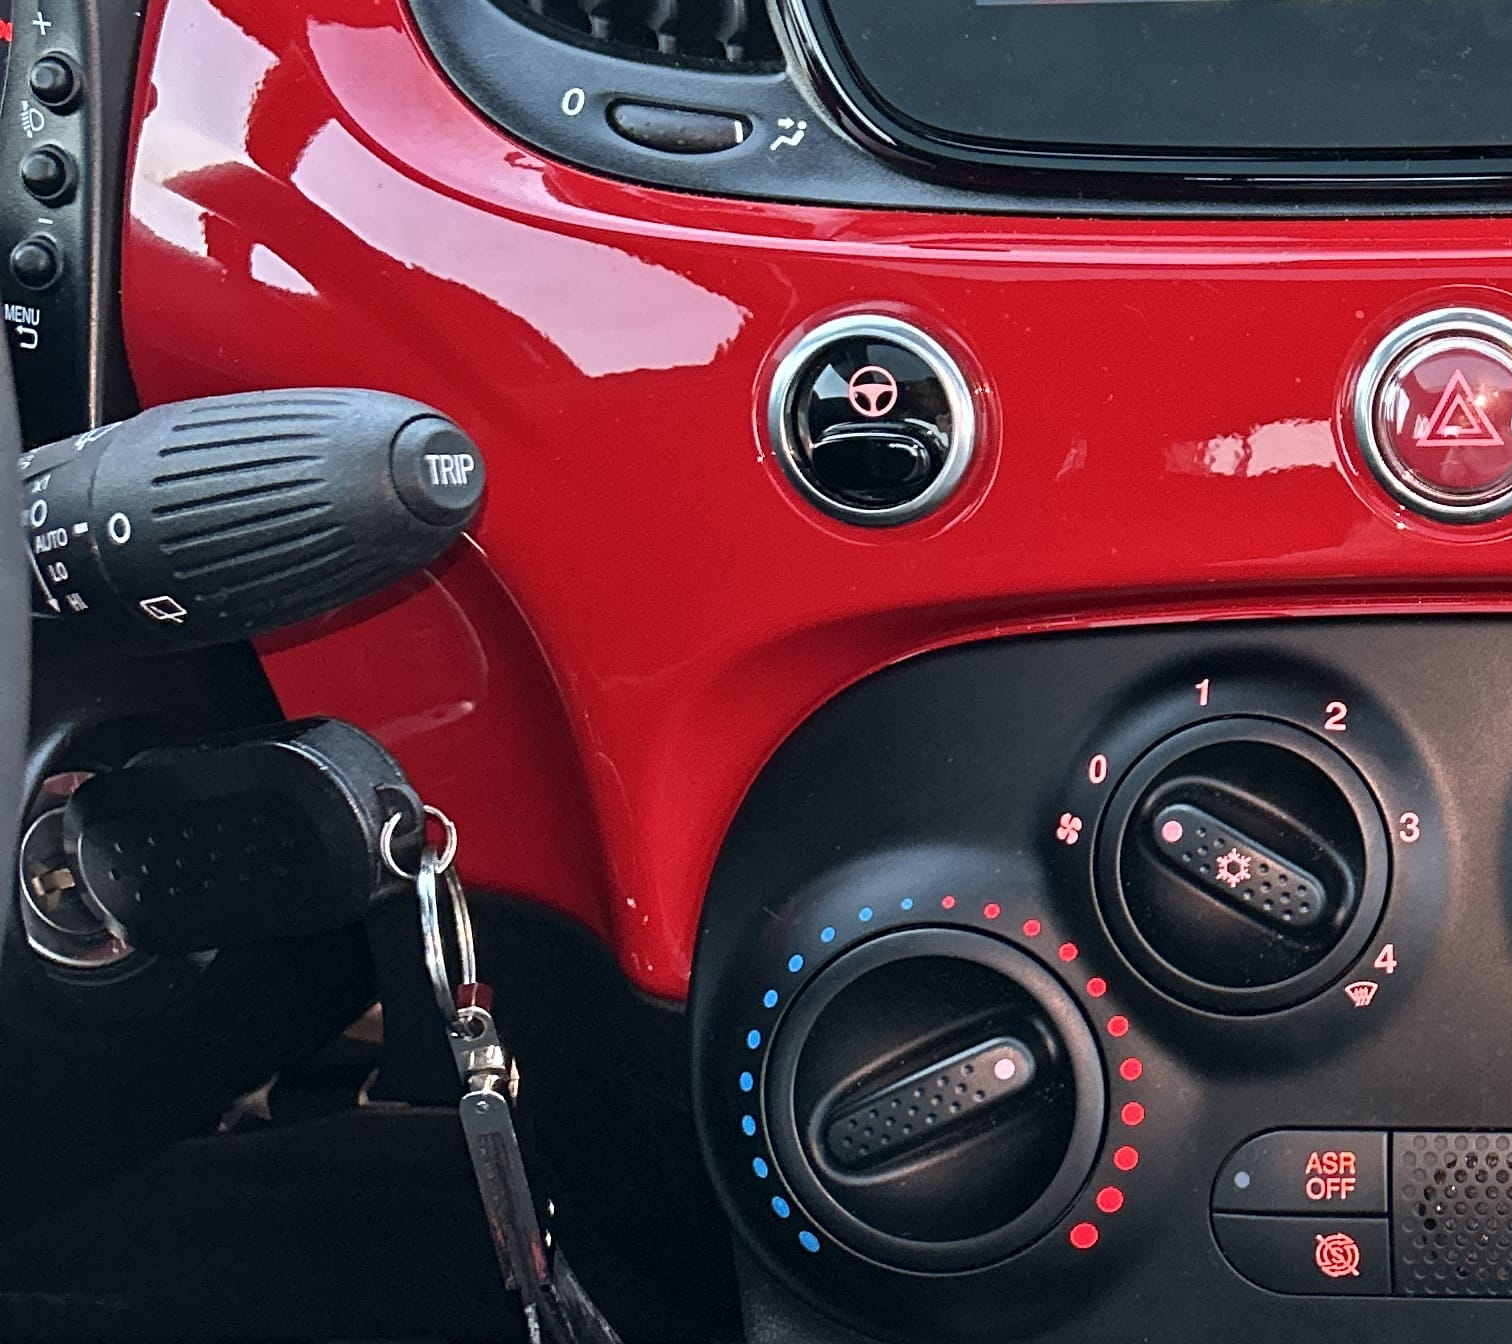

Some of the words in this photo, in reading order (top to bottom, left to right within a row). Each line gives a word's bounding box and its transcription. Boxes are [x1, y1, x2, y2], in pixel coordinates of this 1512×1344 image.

[4, 303, 40, 326] MENU
[423, 454, 475, 486] TRIP
[35, 527, 68, 554] AUTO
[48, 561, 69, 583] LO
[1195, 678, 1210, 706] 1
[1324, 701, 1347, 731] 2
[1398, 812, 1421, 843] 3
[1373, 943, 1398, 974] 4
[1304, 1151, 1357, 1175] ASR
[1306, 1177, 1356, 1200] OFF
